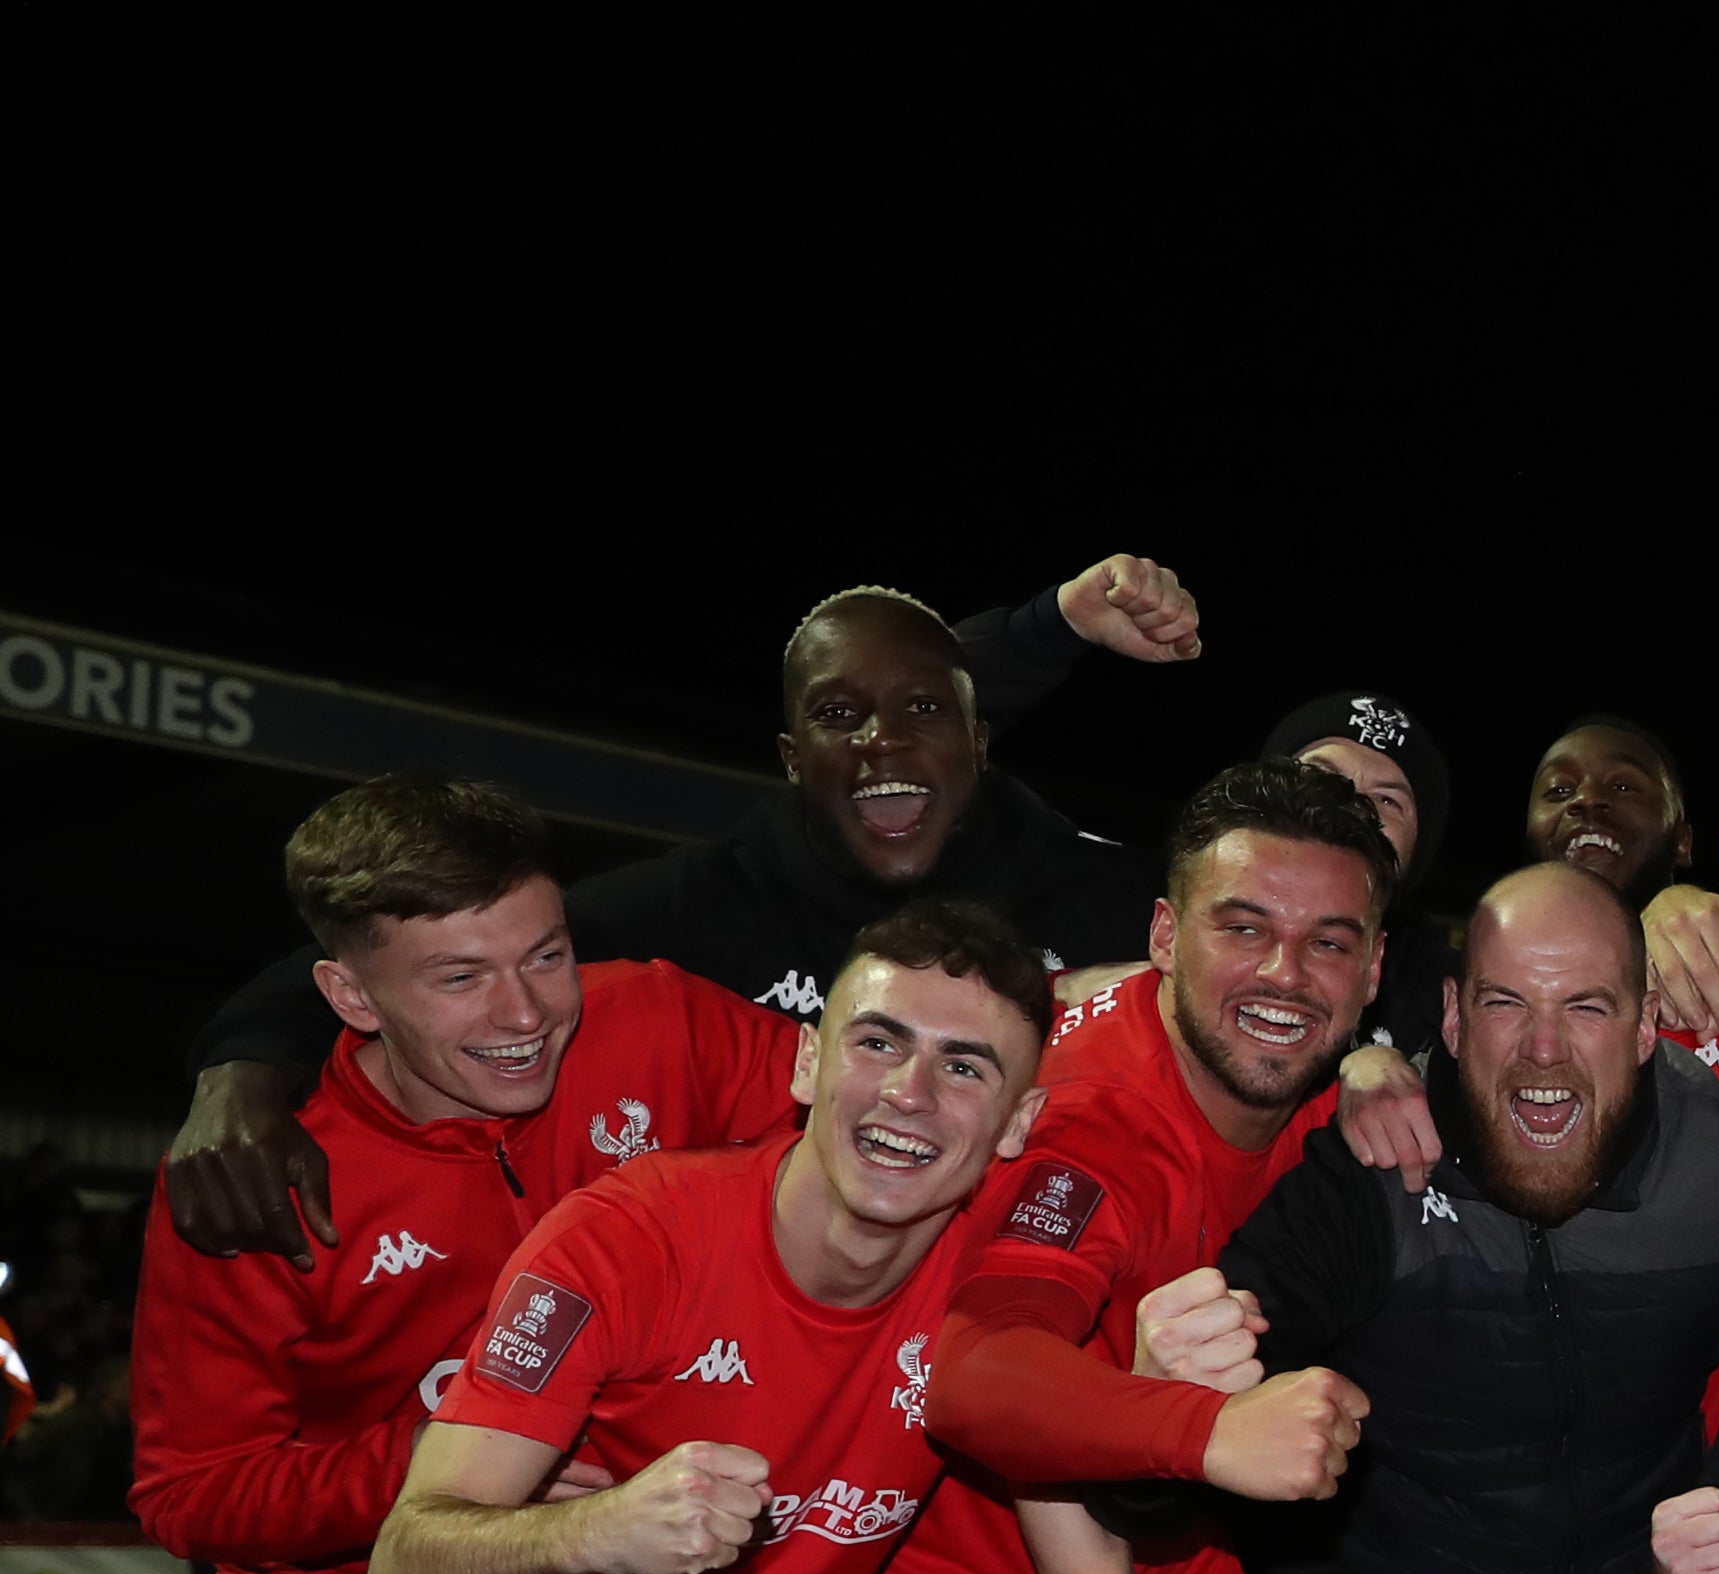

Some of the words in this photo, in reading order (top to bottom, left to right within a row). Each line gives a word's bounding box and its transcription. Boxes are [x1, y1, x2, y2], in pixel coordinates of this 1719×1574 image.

[0, 635, 256, 748] ORIES
[1010, 1210, 1031, 1226] FA
[1033, 1216, 1069, 1237] CUP
[486, 1339, 501, 1356] FA
[504, 1346, 542, 1369] CUP
[493, 1326, 549, 1358] Emirates
